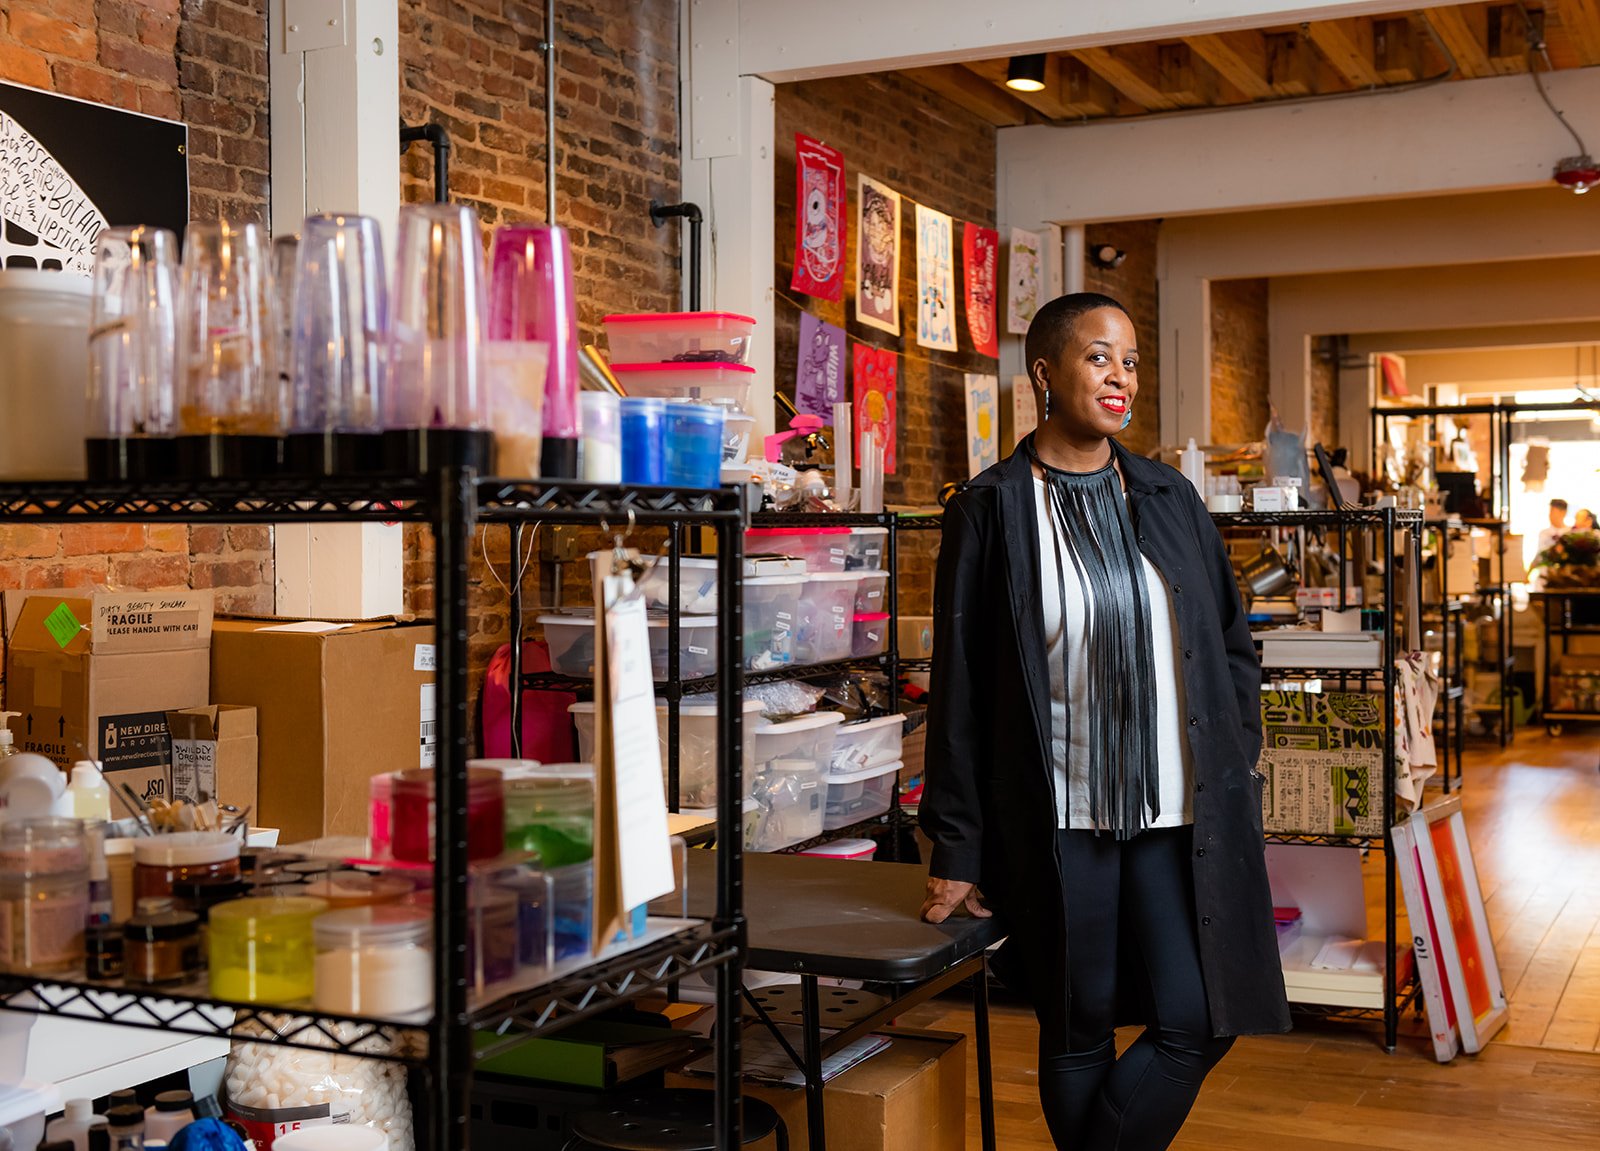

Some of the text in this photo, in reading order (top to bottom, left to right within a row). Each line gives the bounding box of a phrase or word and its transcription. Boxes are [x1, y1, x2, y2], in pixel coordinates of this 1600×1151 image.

[20, 132, 54, 168] BASE
[37, 213, 87, 256] LIPSTICK
[826, 344, 839, 400] WILDER
[100, 605, 121, 617] DIRTY
[126, 602, 154, 613] BEAUTY
[106, 626, 130, 635] LEASE
[132, 625, 161, 634] HANDLE
[163, 624, 181, 633] WITH
[120, 722, 169, 736] NEW DIRE
[24, 741, 67, 755] FRAGILE
[180, 745, 212, 754] WILDLY
[177, 752, 212, 763] ORGANIC
